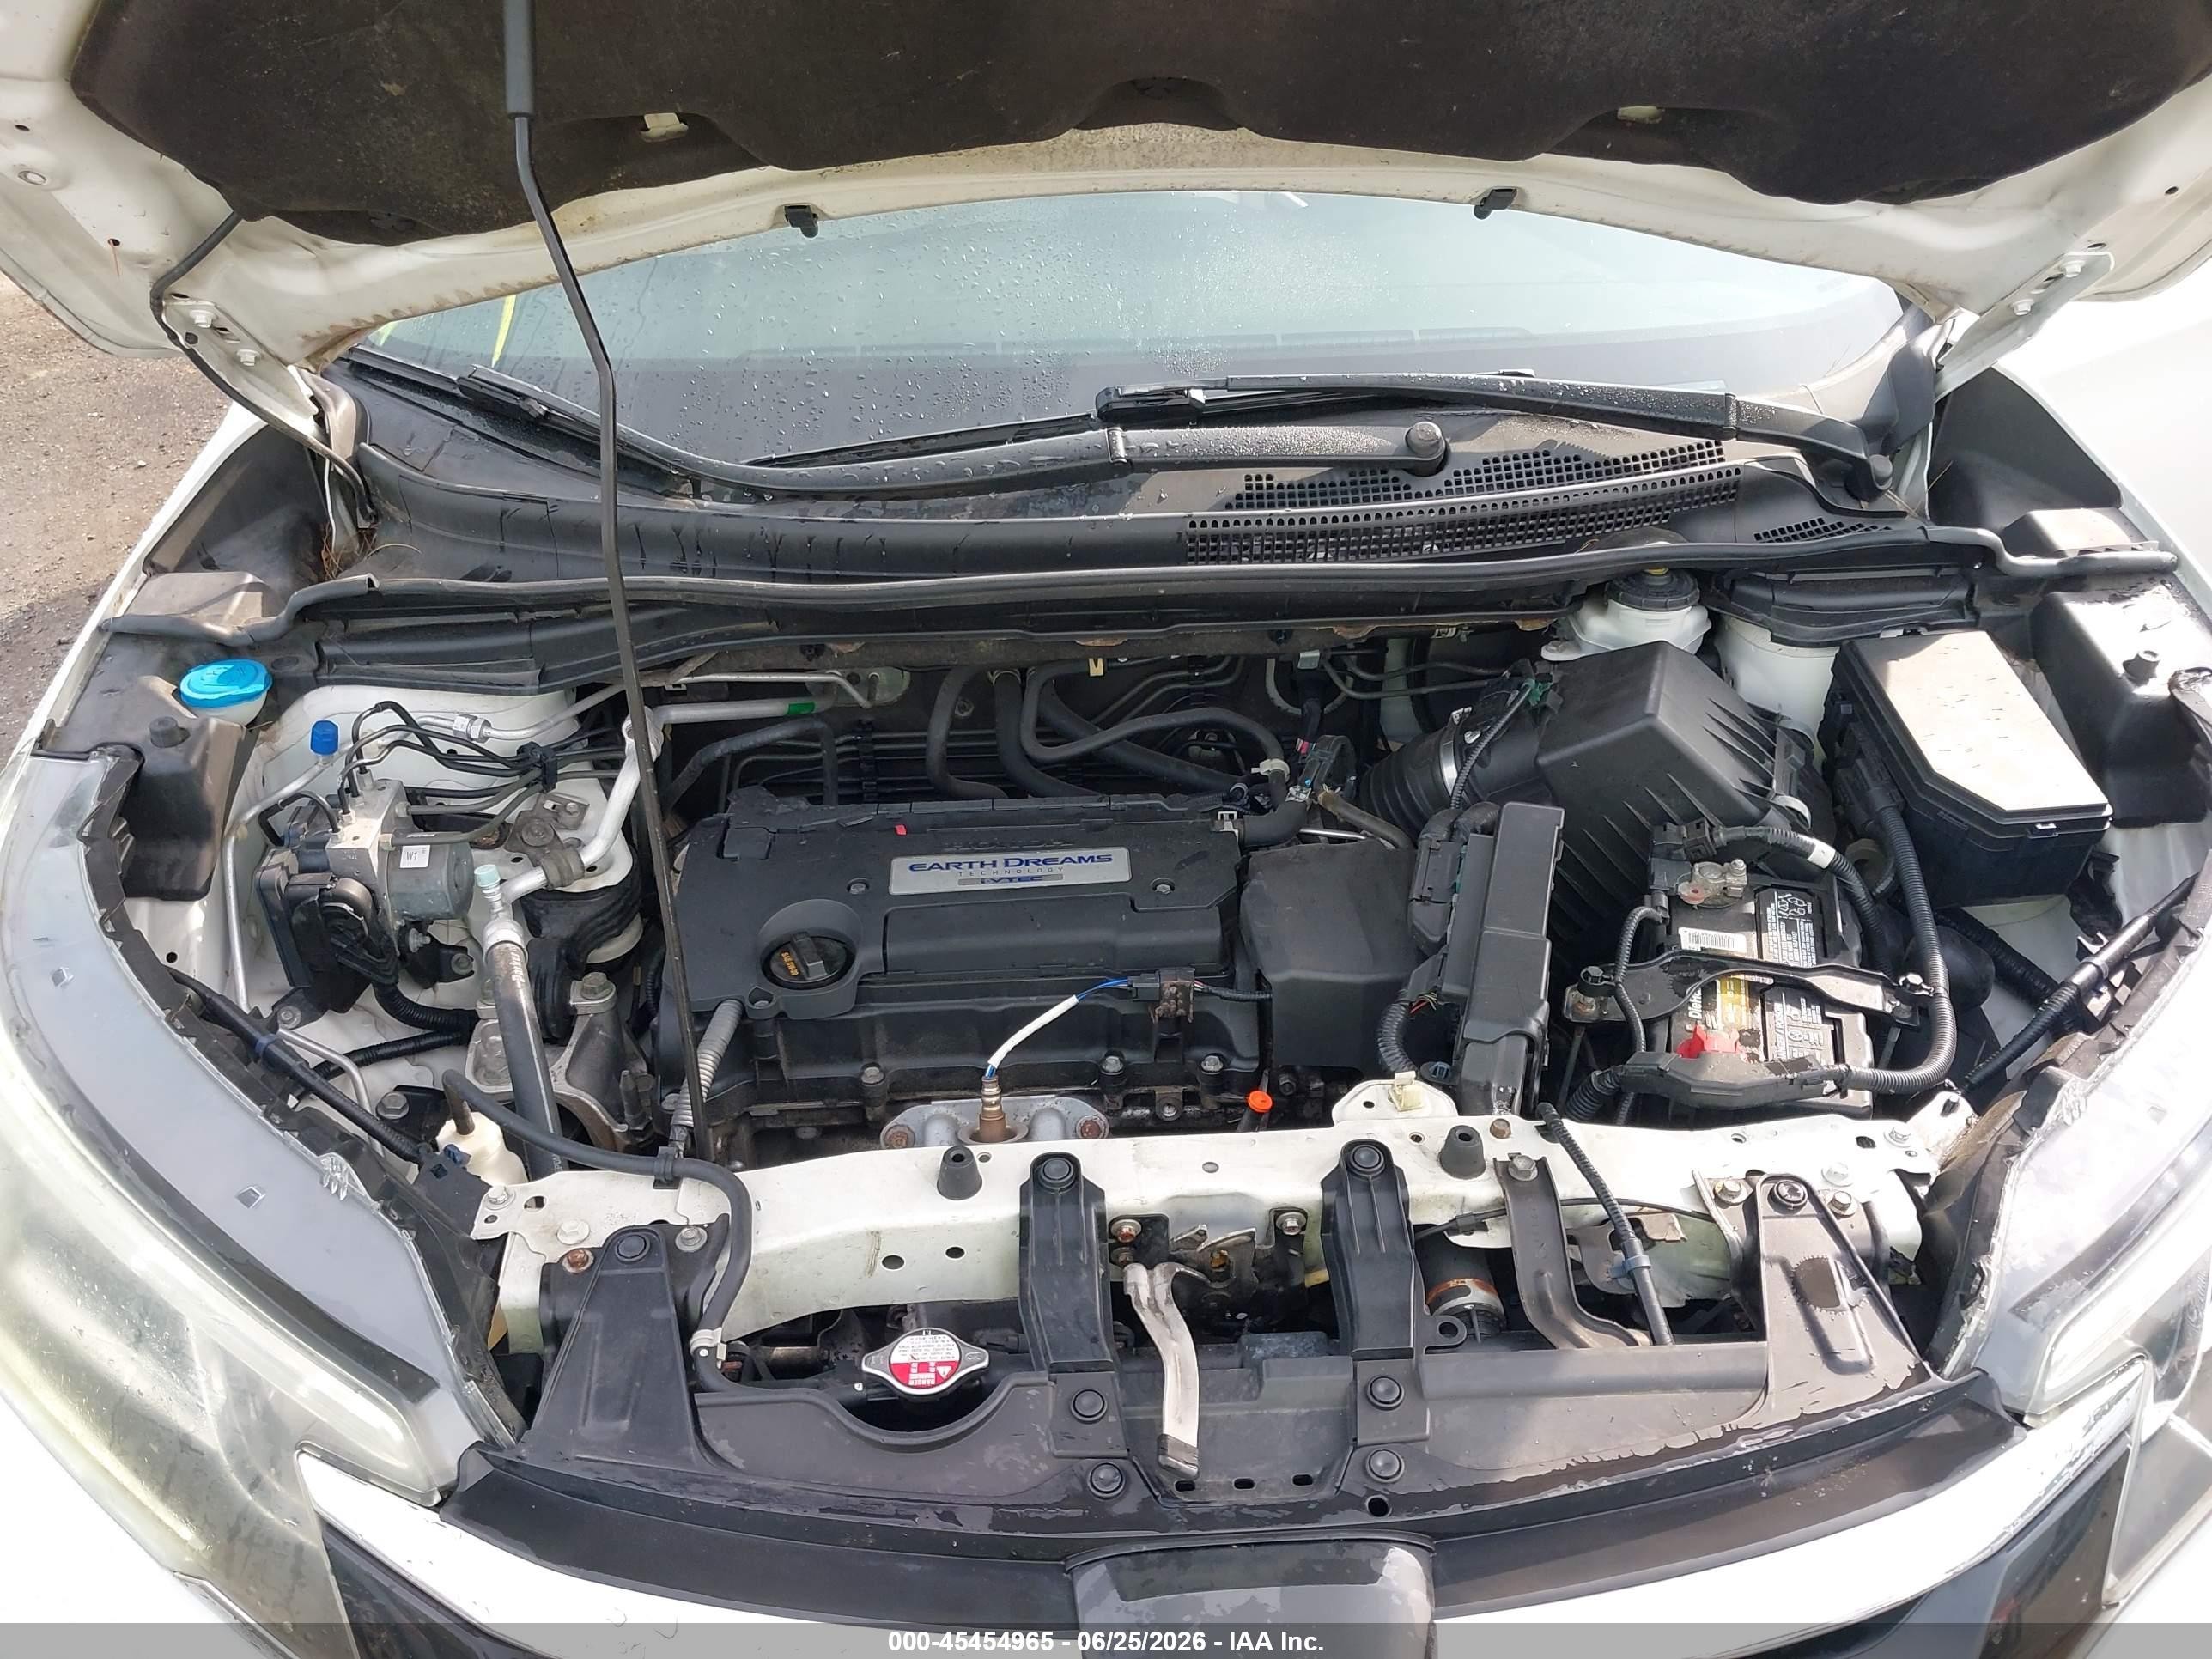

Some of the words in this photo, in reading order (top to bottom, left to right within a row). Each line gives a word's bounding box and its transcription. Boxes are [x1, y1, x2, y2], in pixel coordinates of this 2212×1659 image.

[908, 860, 997, 872] EARTH
[1003, 854, 1113, 868] DREAMS
[958, 866, 1065, 877] TECHNOLOGY
